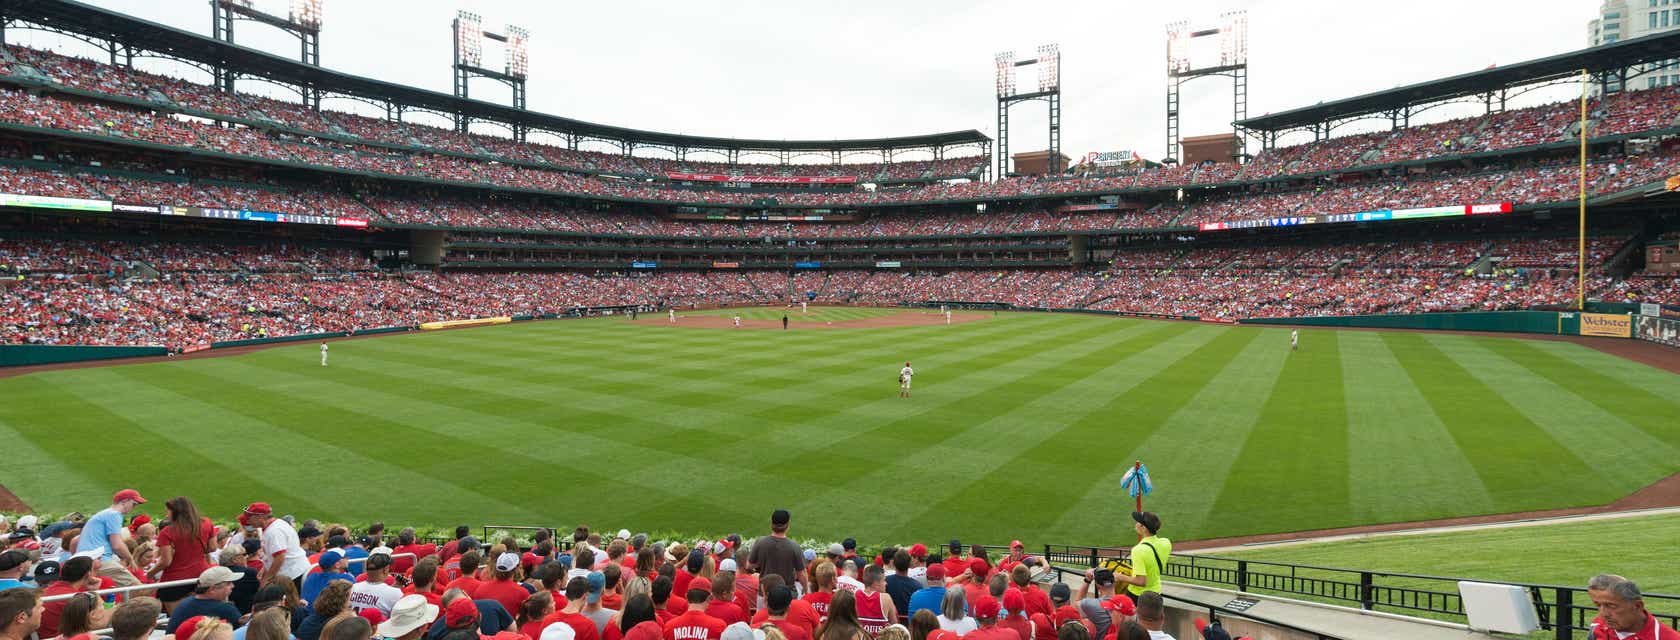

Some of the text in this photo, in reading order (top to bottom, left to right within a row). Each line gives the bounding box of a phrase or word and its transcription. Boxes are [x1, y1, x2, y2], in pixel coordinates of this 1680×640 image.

[1583, 316, 1629, 327] Webster
[350, 592, 379, 605] GIBSON
[674, 626, 708, 640] MOLINA
